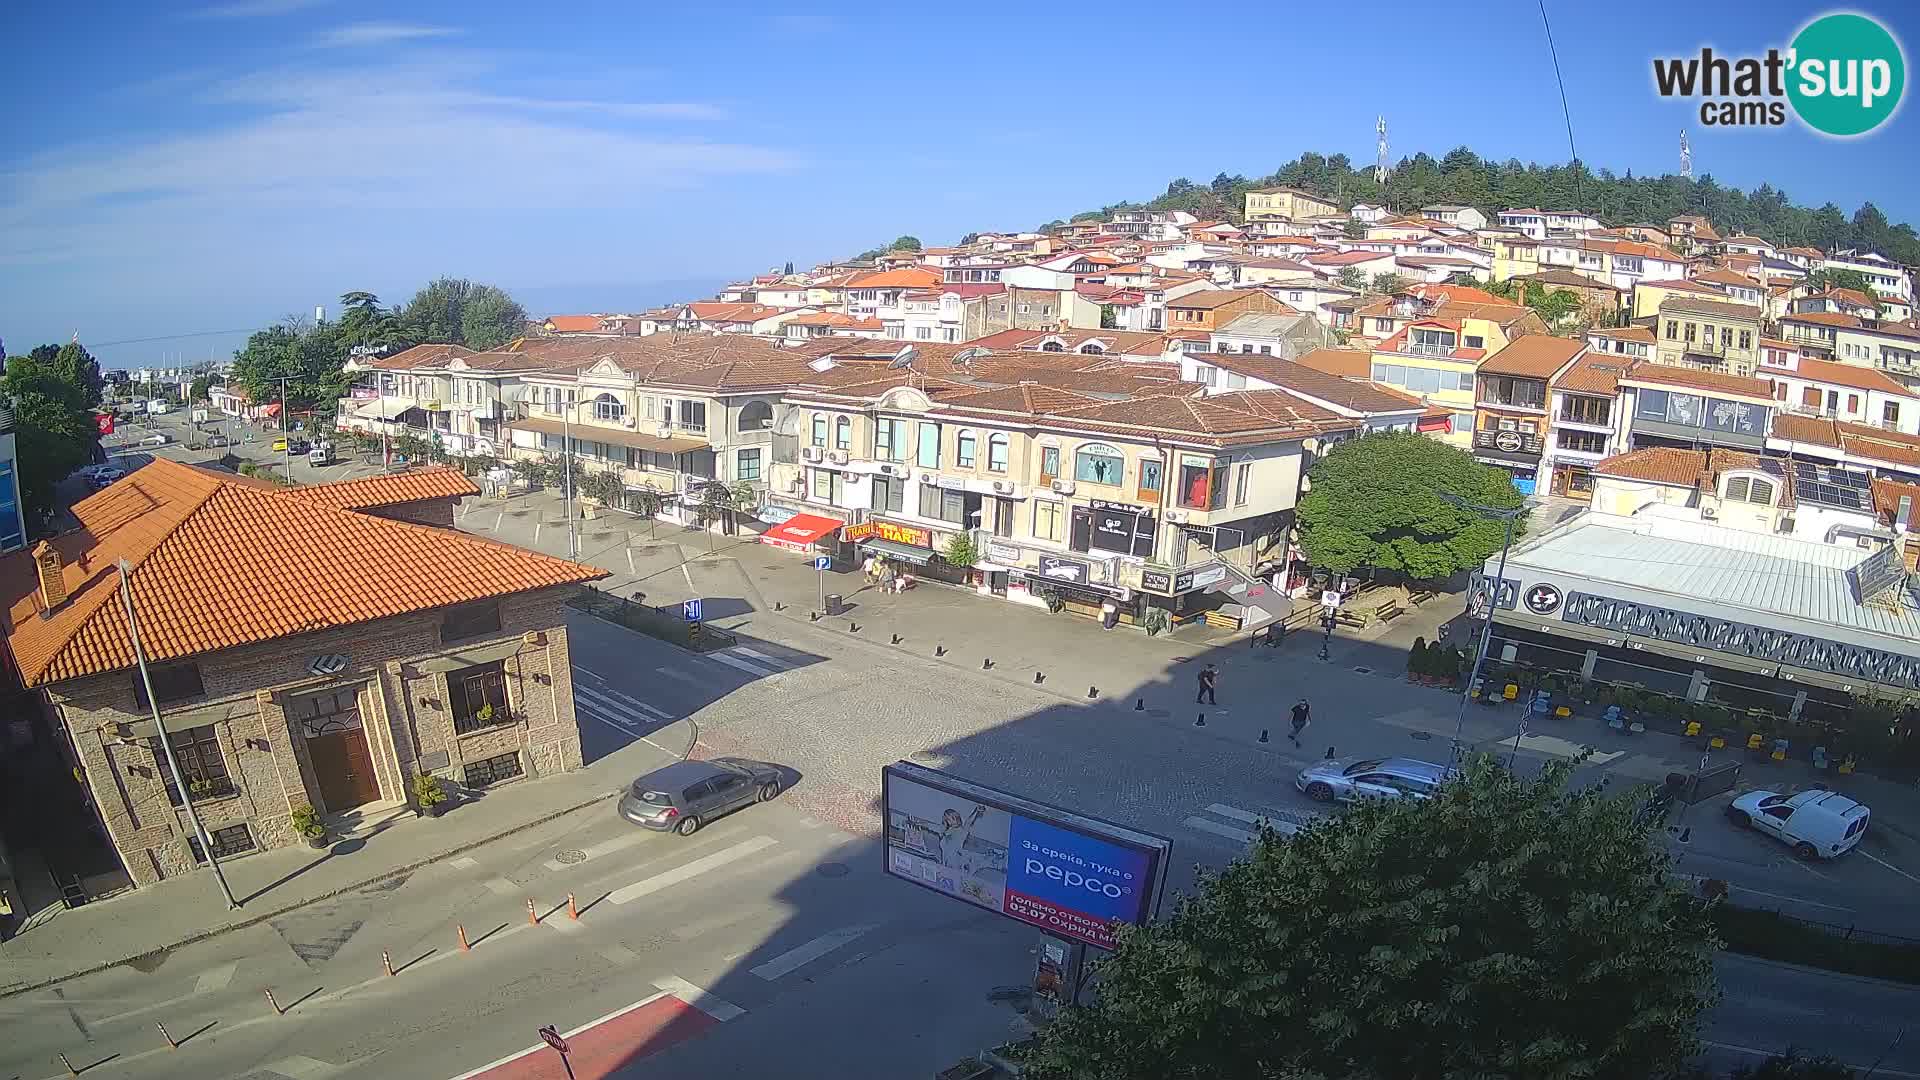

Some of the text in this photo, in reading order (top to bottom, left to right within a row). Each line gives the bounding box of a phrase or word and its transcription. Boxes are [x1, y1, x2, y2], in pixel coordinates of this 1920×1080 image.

[1022, 840, 1039, 852] За
[1090, 862, 1120, 876] тука
[1025, 858, 1122, 898] pepco
[1009, 902, 1046, 920] 02.07
[1049, 916, 1096, 939] Охрид
